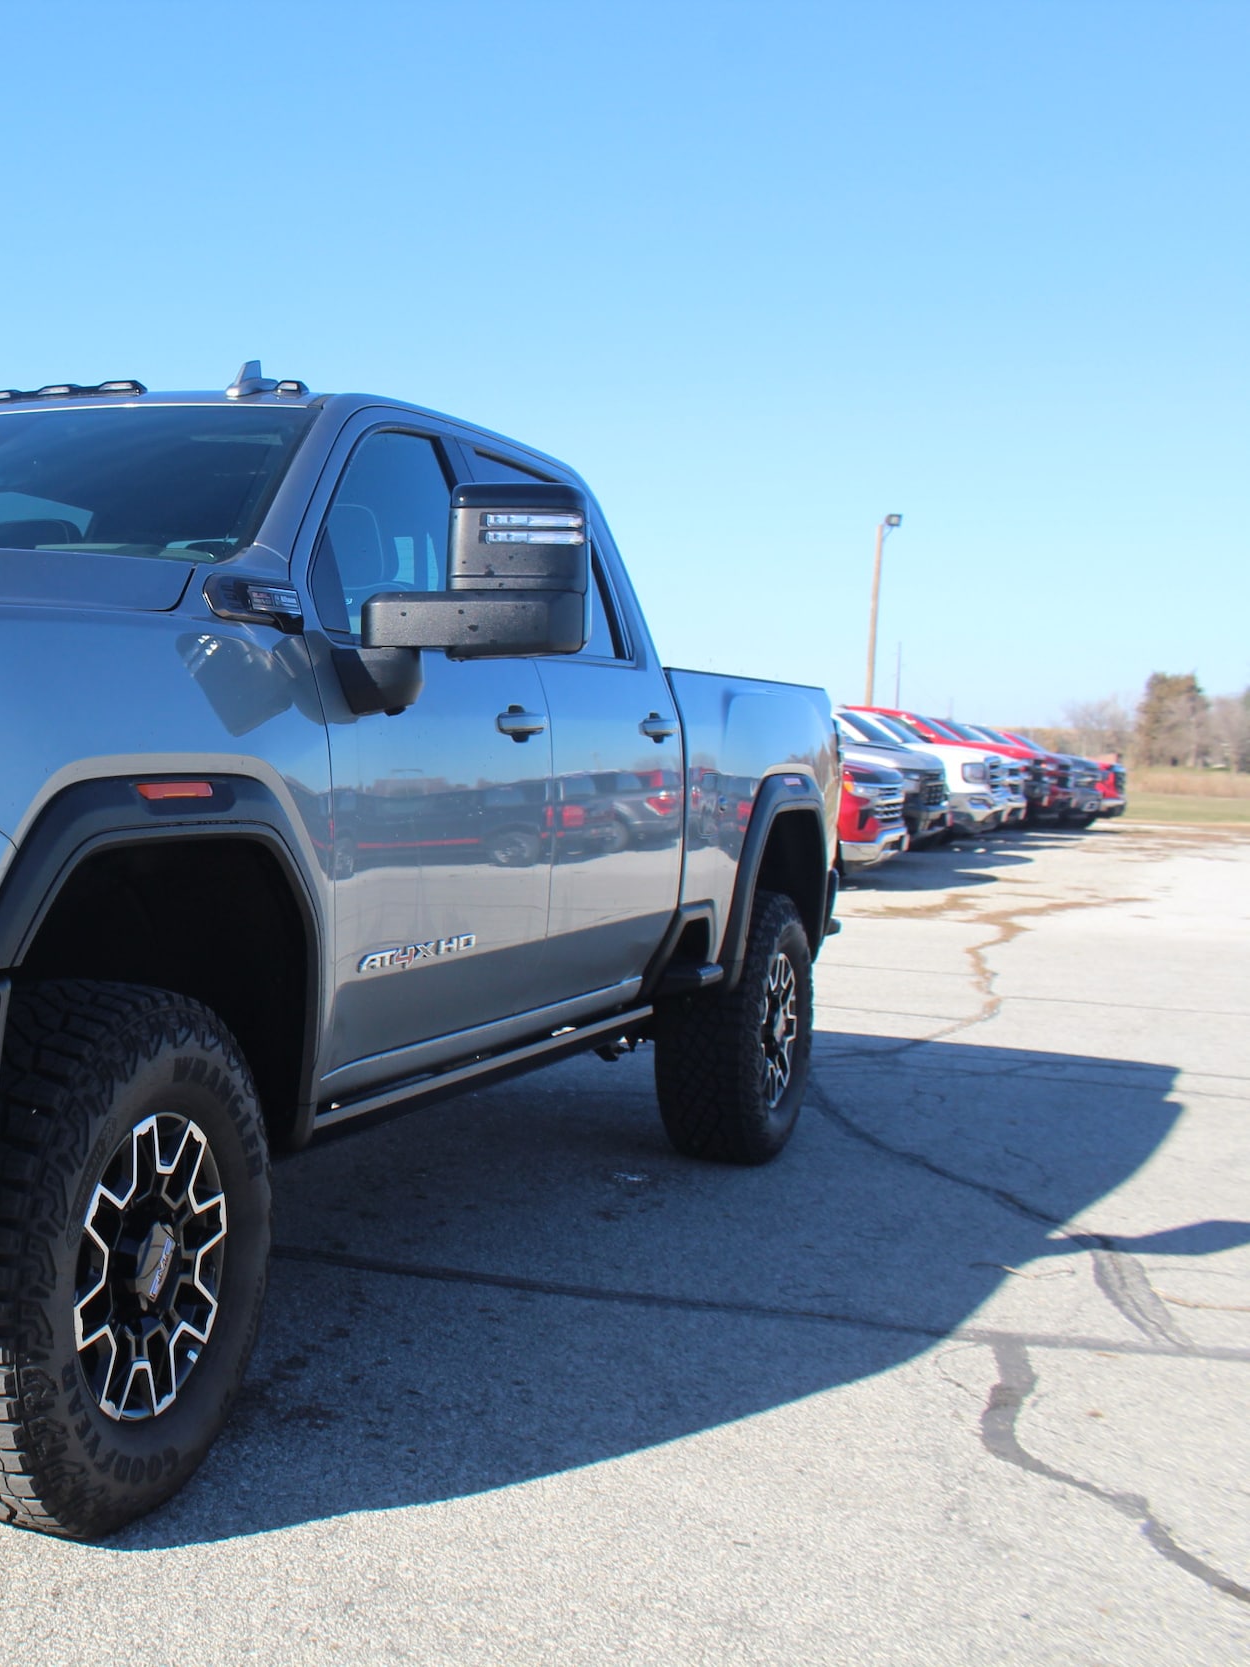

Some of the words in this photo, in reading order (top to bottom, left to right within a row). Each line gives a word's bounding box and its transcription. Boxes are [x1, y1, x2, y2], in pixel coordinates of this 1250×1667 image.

[356, 941, 434, 973] AT4X
[436, 933, 477, 956] HD
[173, 1056, 263, 1180] WRANGLER
